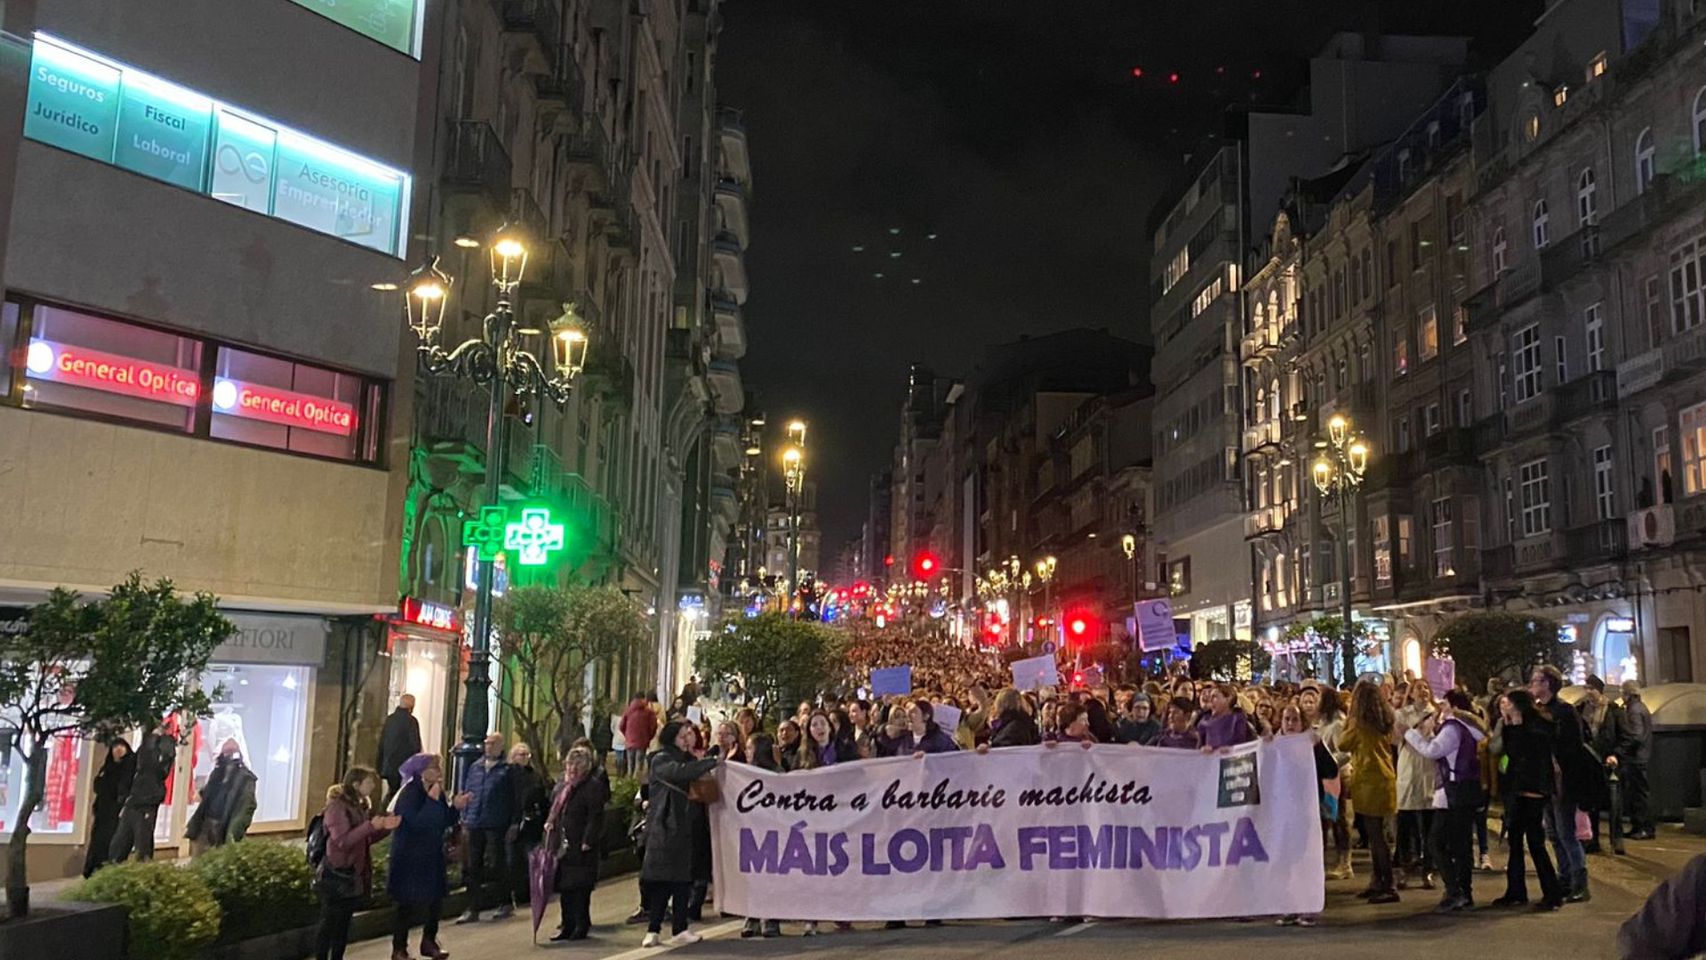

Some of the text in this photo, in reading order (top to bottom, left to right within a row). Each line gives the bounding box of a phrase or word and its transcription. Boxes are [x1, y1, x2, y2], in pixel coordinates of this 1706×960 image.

[36, 66, 105, 103] Seguros
[33, 102, 99, 135] Jurídico
[145, 105, 186, 131] Fiscal
[133, 134, 191, 165] Laboral
[58, 353, 197, 396] General Optica
[241, 390, 350, 427] General Optica
[736, 772, 1153, 813] Contra a barbarie machista
[739, 816, 1270, 877] MÁIS LOITA FEMINISTA
